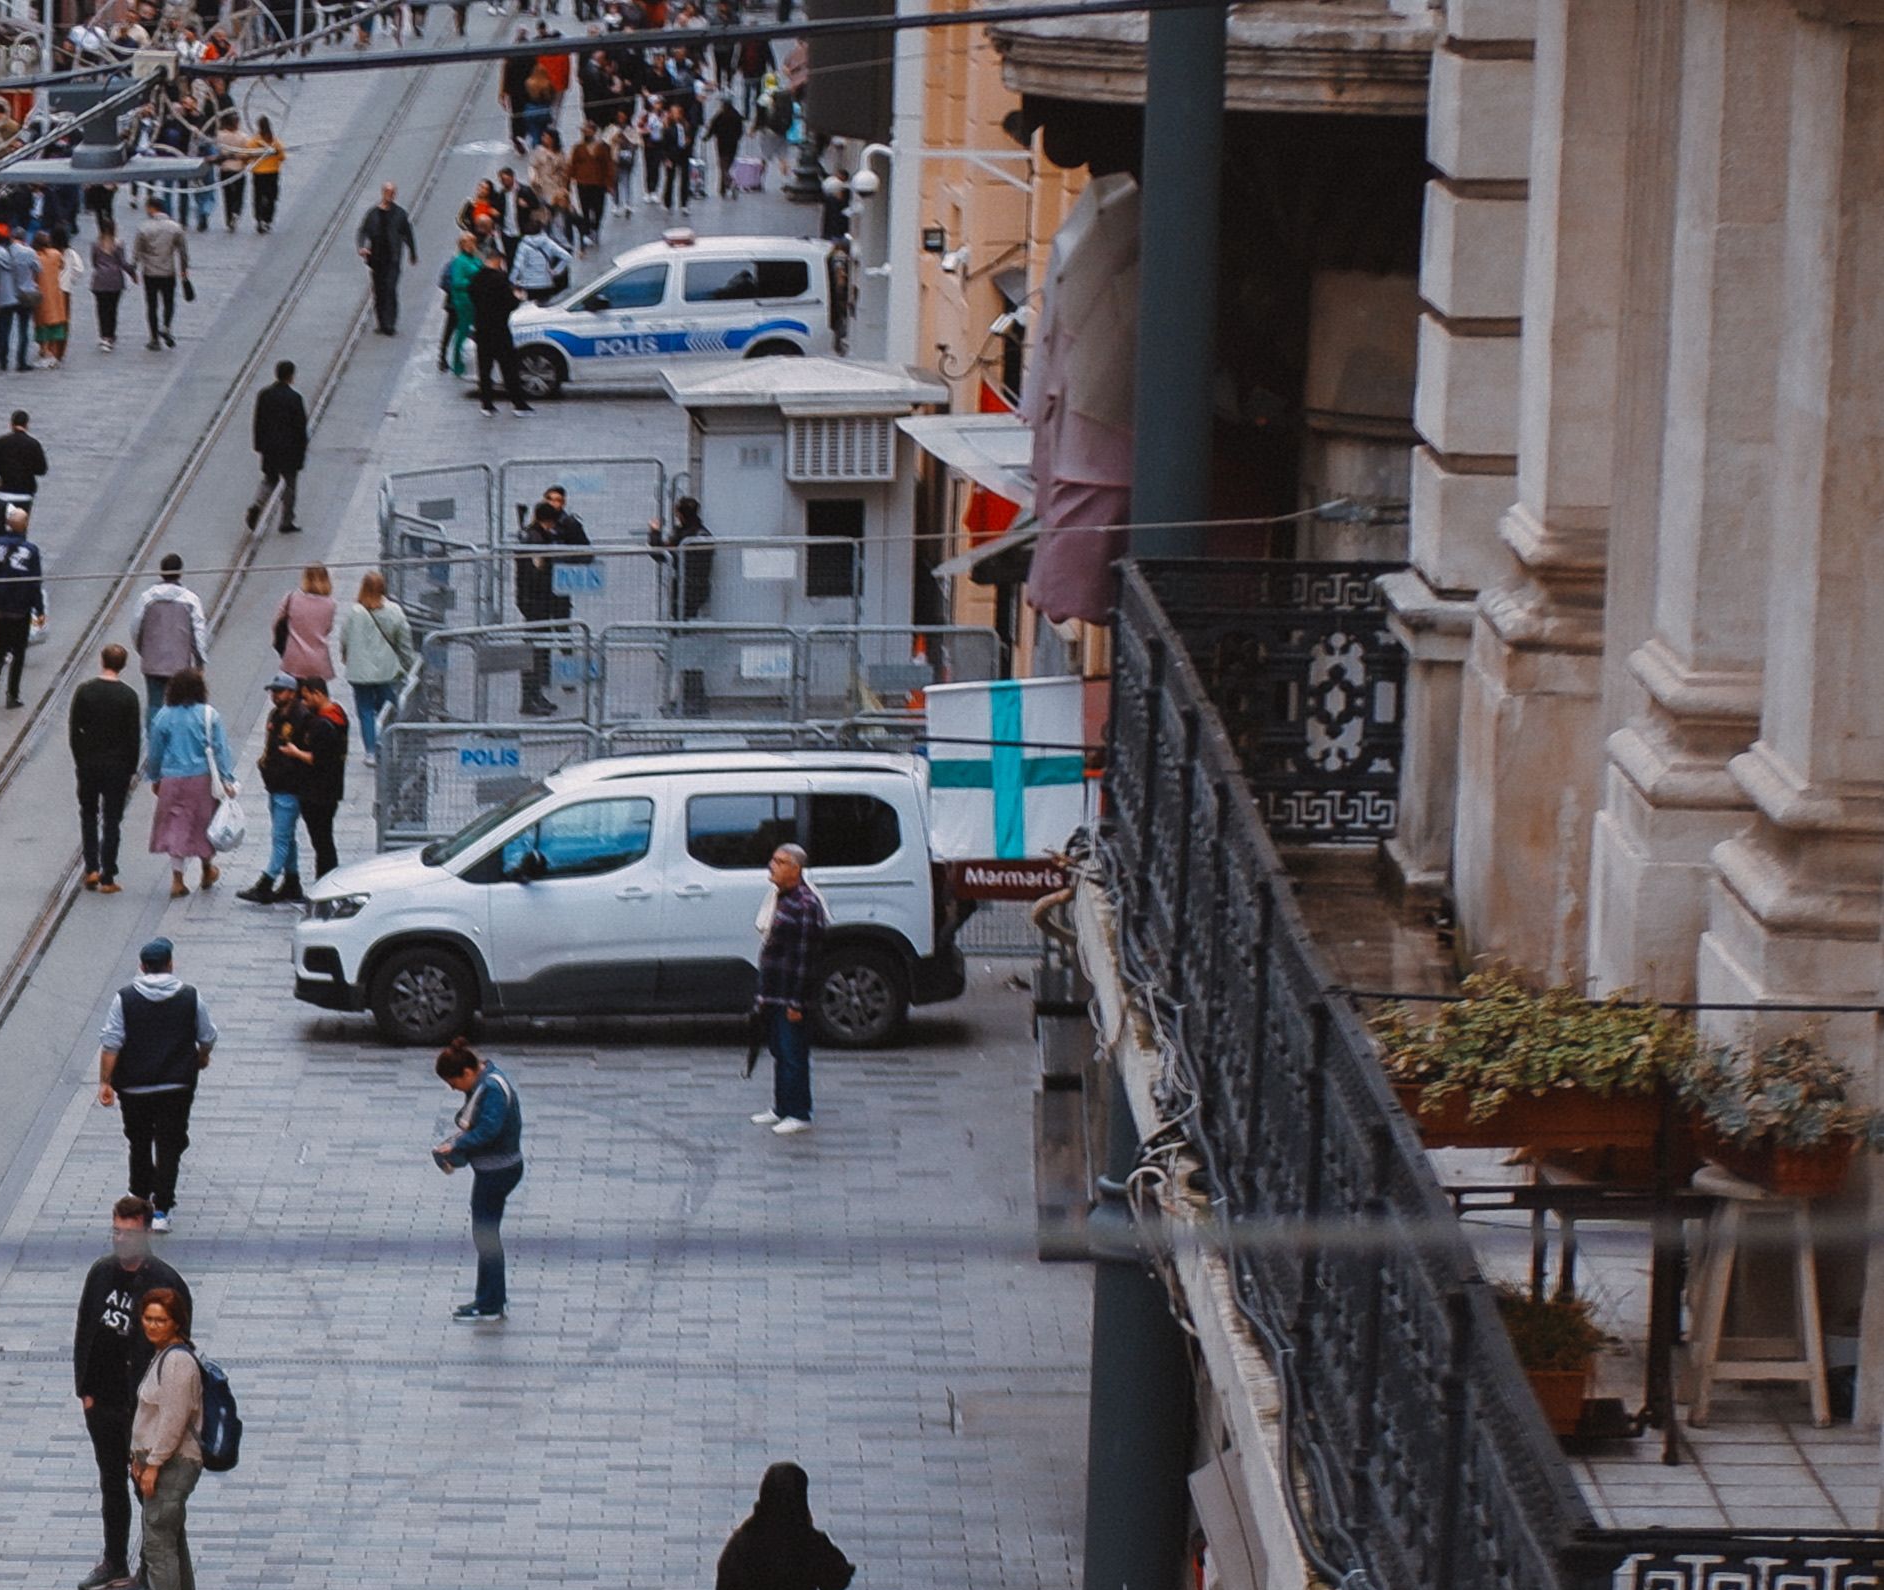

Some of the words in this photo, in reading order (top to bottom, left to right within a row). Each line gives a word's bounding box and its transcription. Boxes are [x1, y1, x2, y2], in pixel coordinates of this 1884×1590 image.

[594, 334, 659, 356] POLİS
[460, 747, 520, 767] POLİS
[964, 866, 1063, 888] Marmaris
